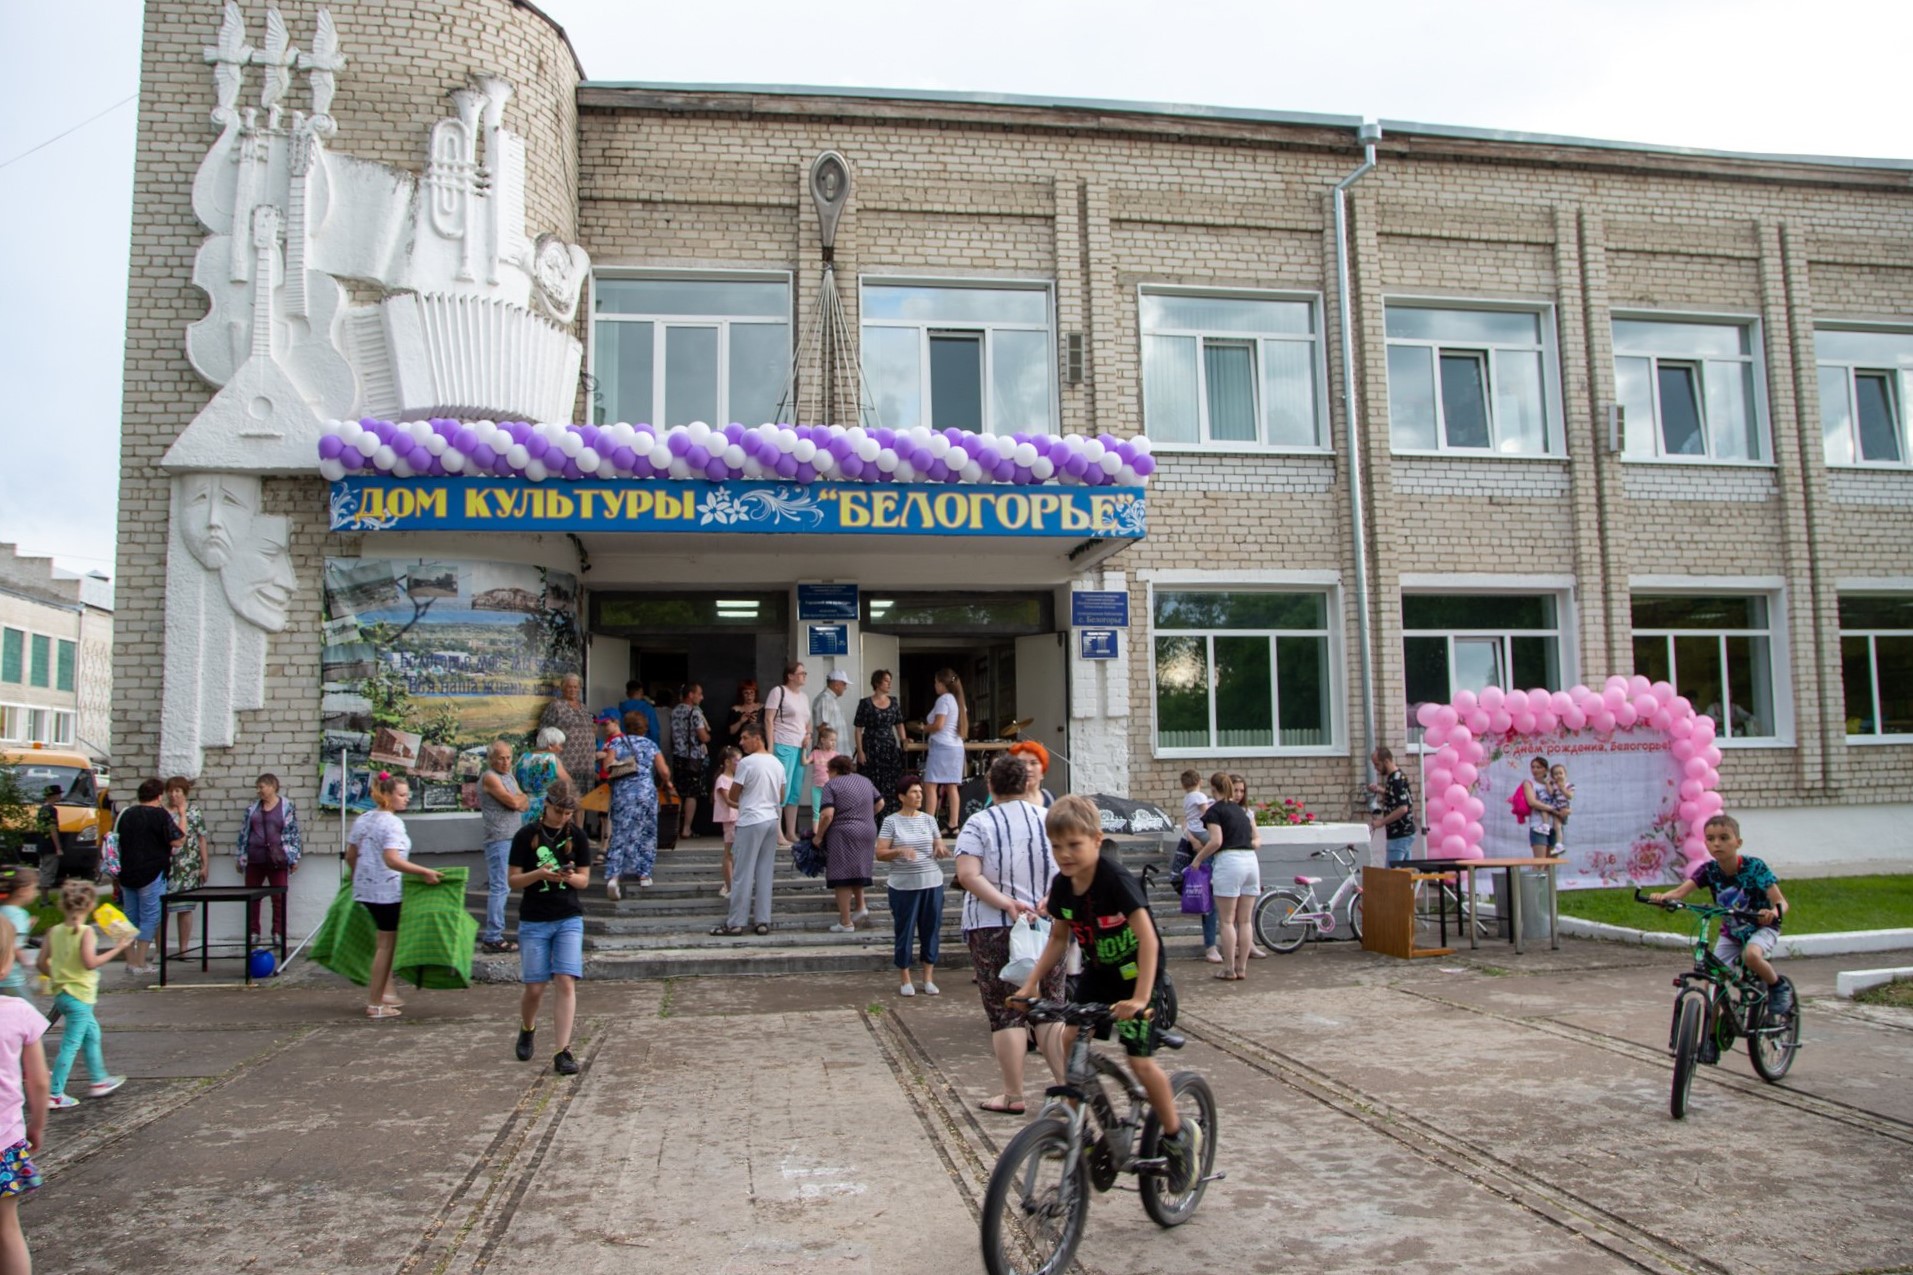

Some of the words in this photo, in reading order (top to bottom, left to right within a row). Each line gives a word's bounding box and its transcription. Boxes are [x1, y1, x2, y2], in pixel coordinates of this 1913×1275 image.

[355, 487, 448, 520] ДОМ
[464, 488, 696, 520] КУЛЬТУРЫ
[1503, 744, 1510, 754] С
